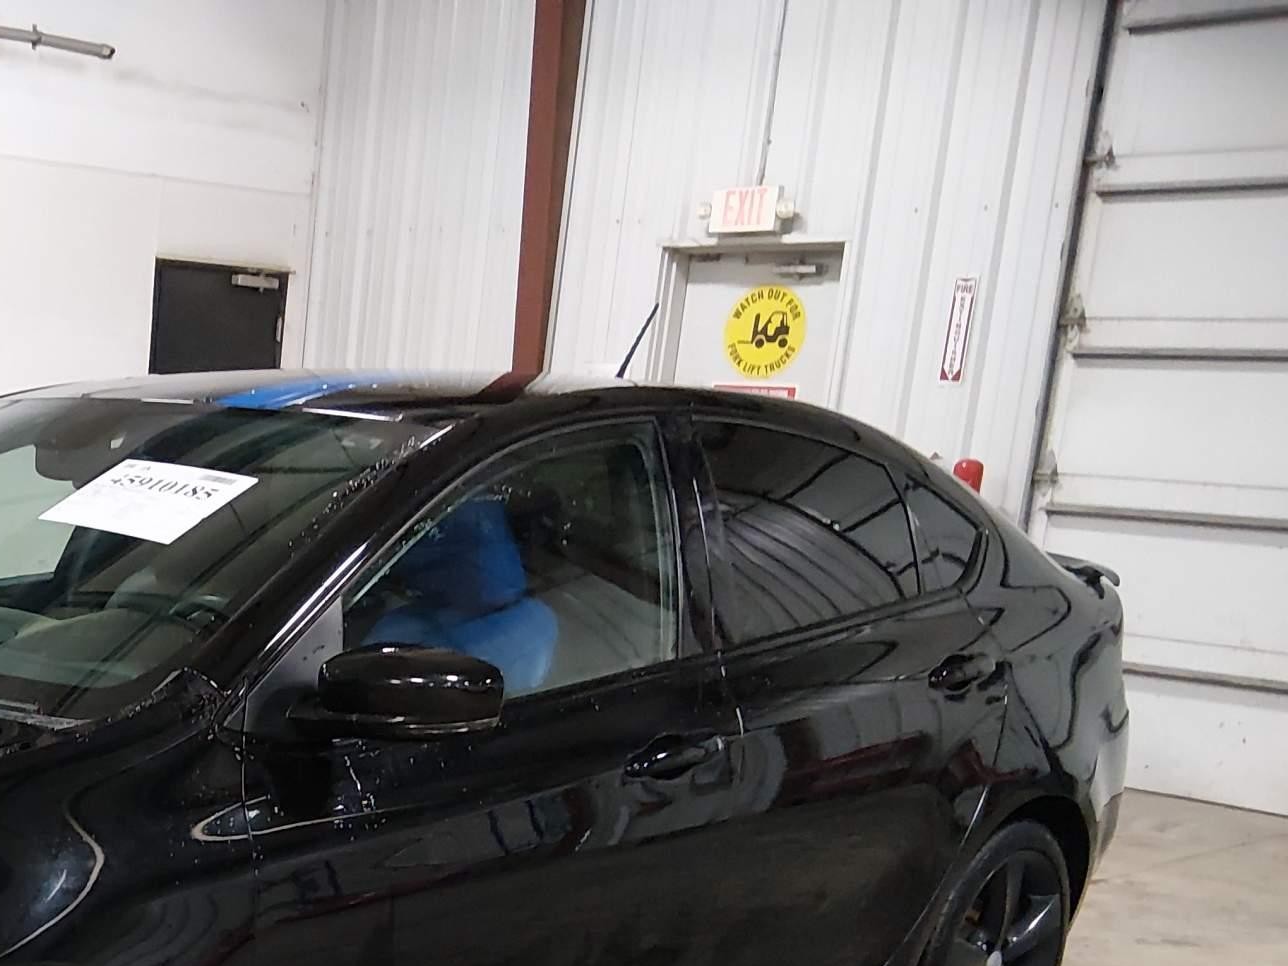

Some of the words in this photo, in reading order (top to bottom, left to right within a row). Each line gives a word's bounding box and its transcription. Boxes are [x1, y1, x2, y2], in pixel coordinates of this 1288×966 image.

[722, 188, 768, 226] EXIT
[732, 289, 765, 320] WATCH
[767, 287, 789, 303] OUT
[785, 298, 801, 321] FOR
[956, 283, 973, 294] FIRE
[728, 342, 744, 367] FORK
[742, 361, 762, 376] LIFT
[763, 345, 796, 376] TRUCKS
[110, 473, 221, 501] 45910185
